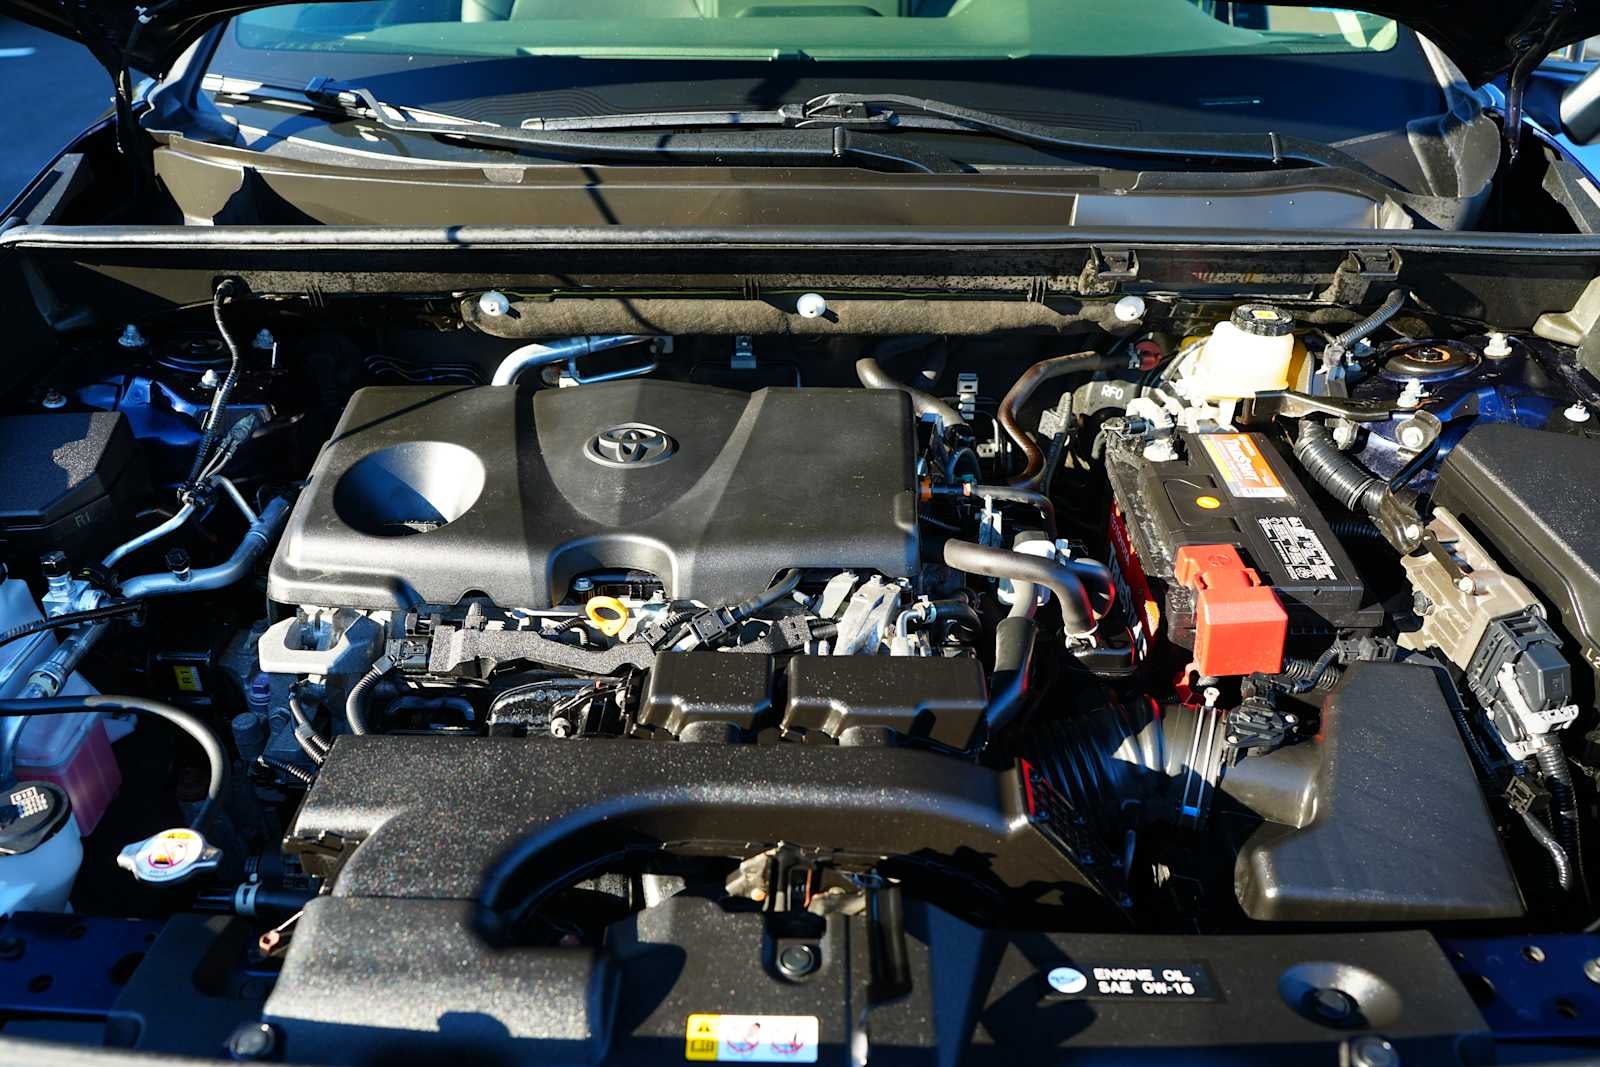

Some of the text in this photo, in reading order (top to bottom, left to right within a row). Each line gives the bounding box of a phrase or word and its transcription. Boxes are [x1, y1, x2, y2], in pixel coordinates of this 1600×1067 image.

[1093, 967, 1191, 982] ENGINE OIL
[1098, 981, 1134, 994] SAE
